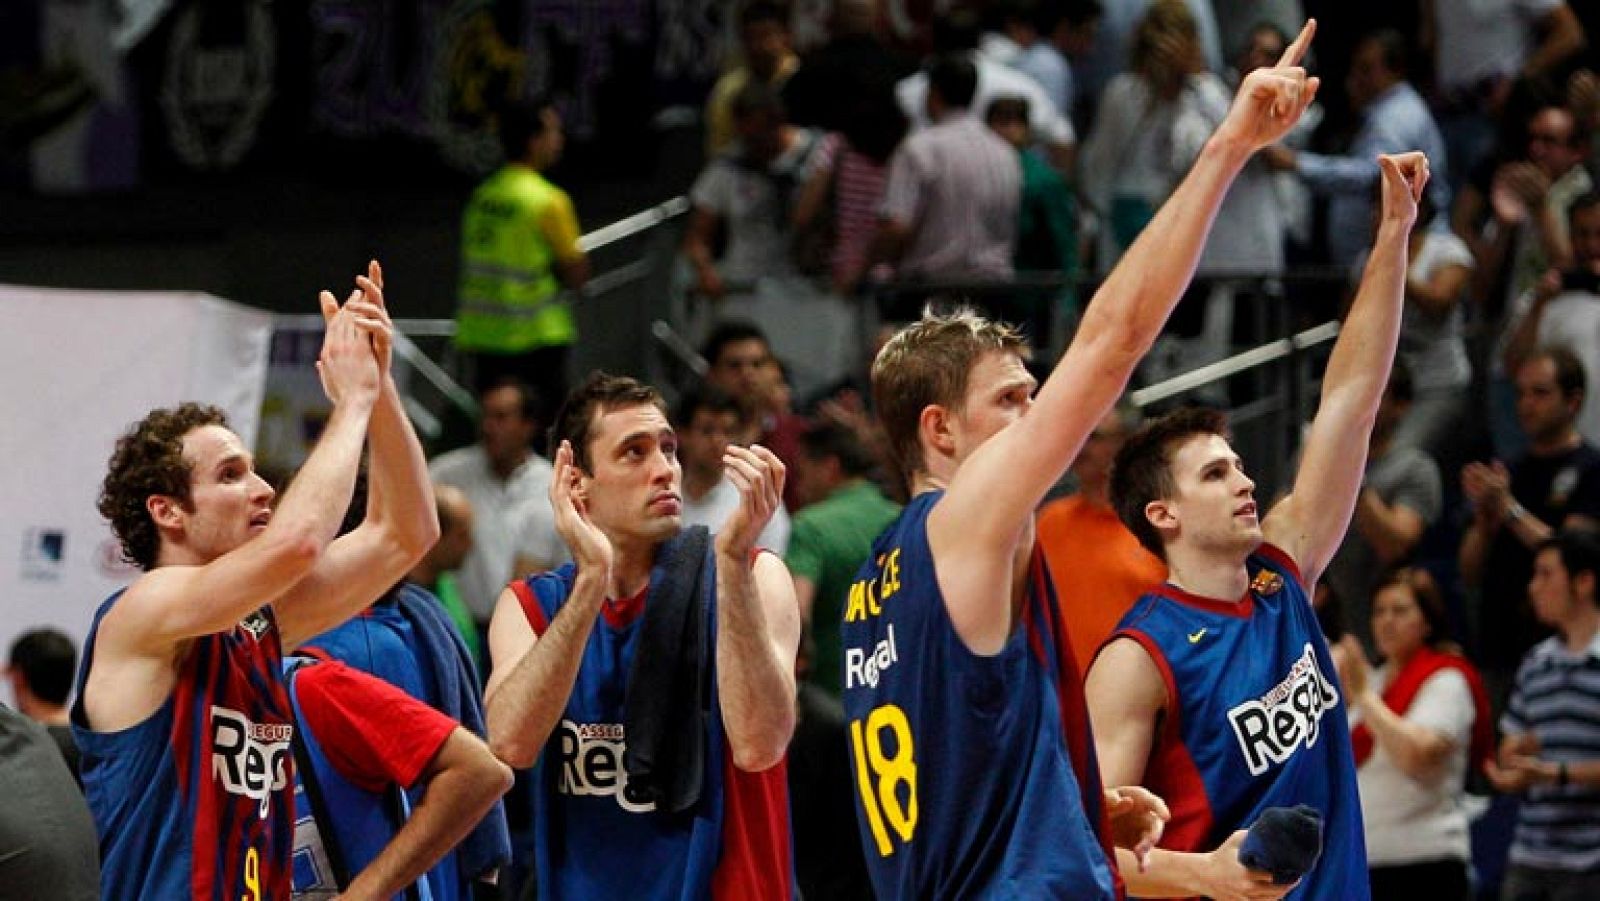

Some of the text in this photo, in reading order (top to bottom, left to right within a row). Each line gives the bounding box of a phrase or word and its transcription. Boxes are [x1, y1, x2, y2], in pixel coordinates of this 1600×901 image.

[1229, 645, 1336, 774] Regal
[851, 704, 919, 857] 18
[242, 847, 261, 901] 9
